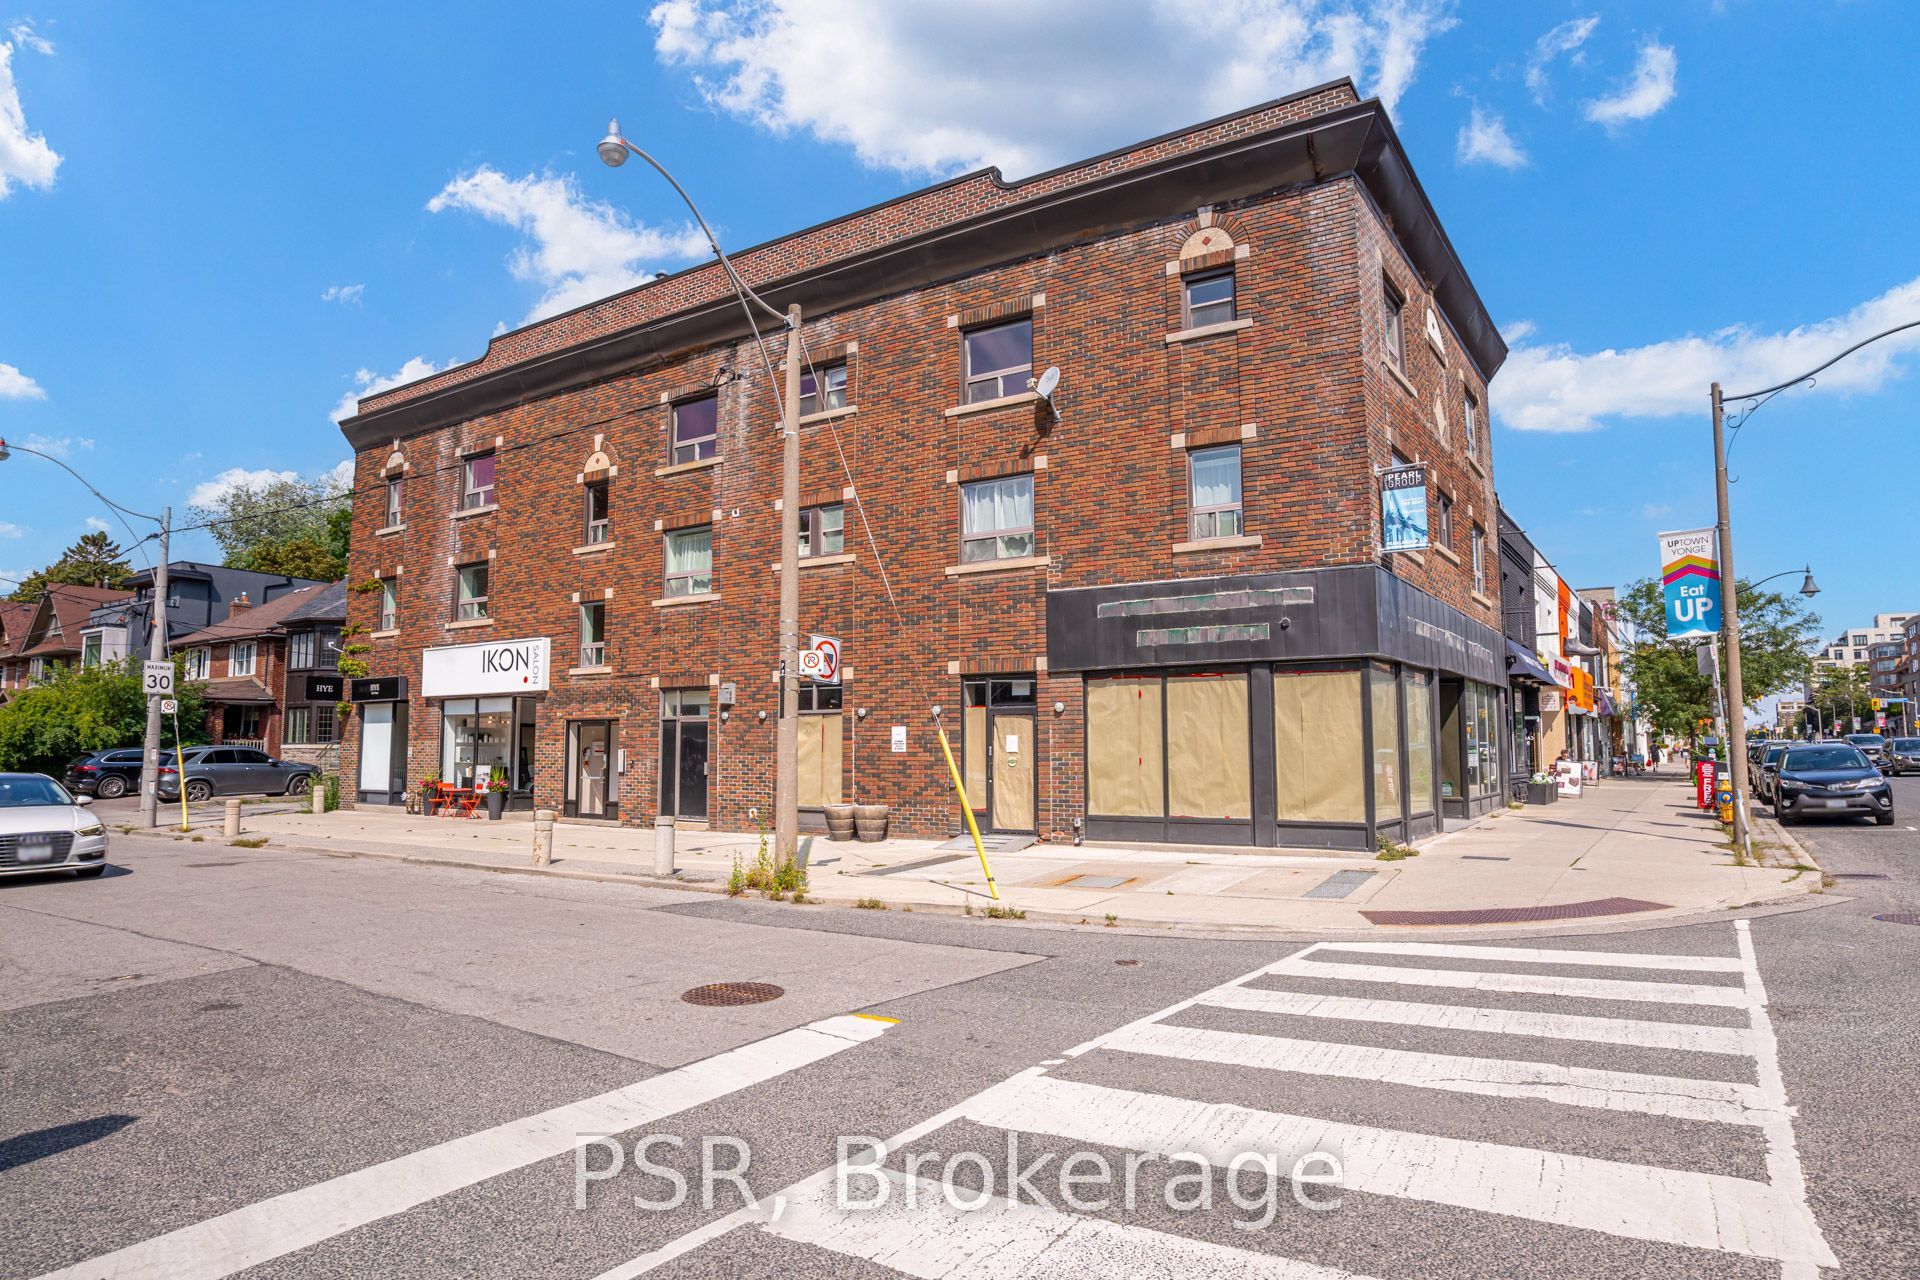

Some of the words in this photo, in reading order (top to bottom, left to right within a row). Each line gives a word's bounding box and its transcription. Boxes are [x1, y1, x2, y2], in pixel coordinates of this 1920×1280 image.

[1388, 470, 1421, 480] PEARL
[1388, 477, 1422, 488] GROUP
[1667, 536, 1709, 548] UPTOWN
[1671, 545, 1707, 556] YONGE
[1680, 584, 1704, 597] Eat
[1674, 597, 1713, 622] UP
[482, 646, 529, 673] IKON
[532, 645, 540, 685] SALON
[147, 674, 170, 690] 30
[316, 684, 334, 693] HYE
